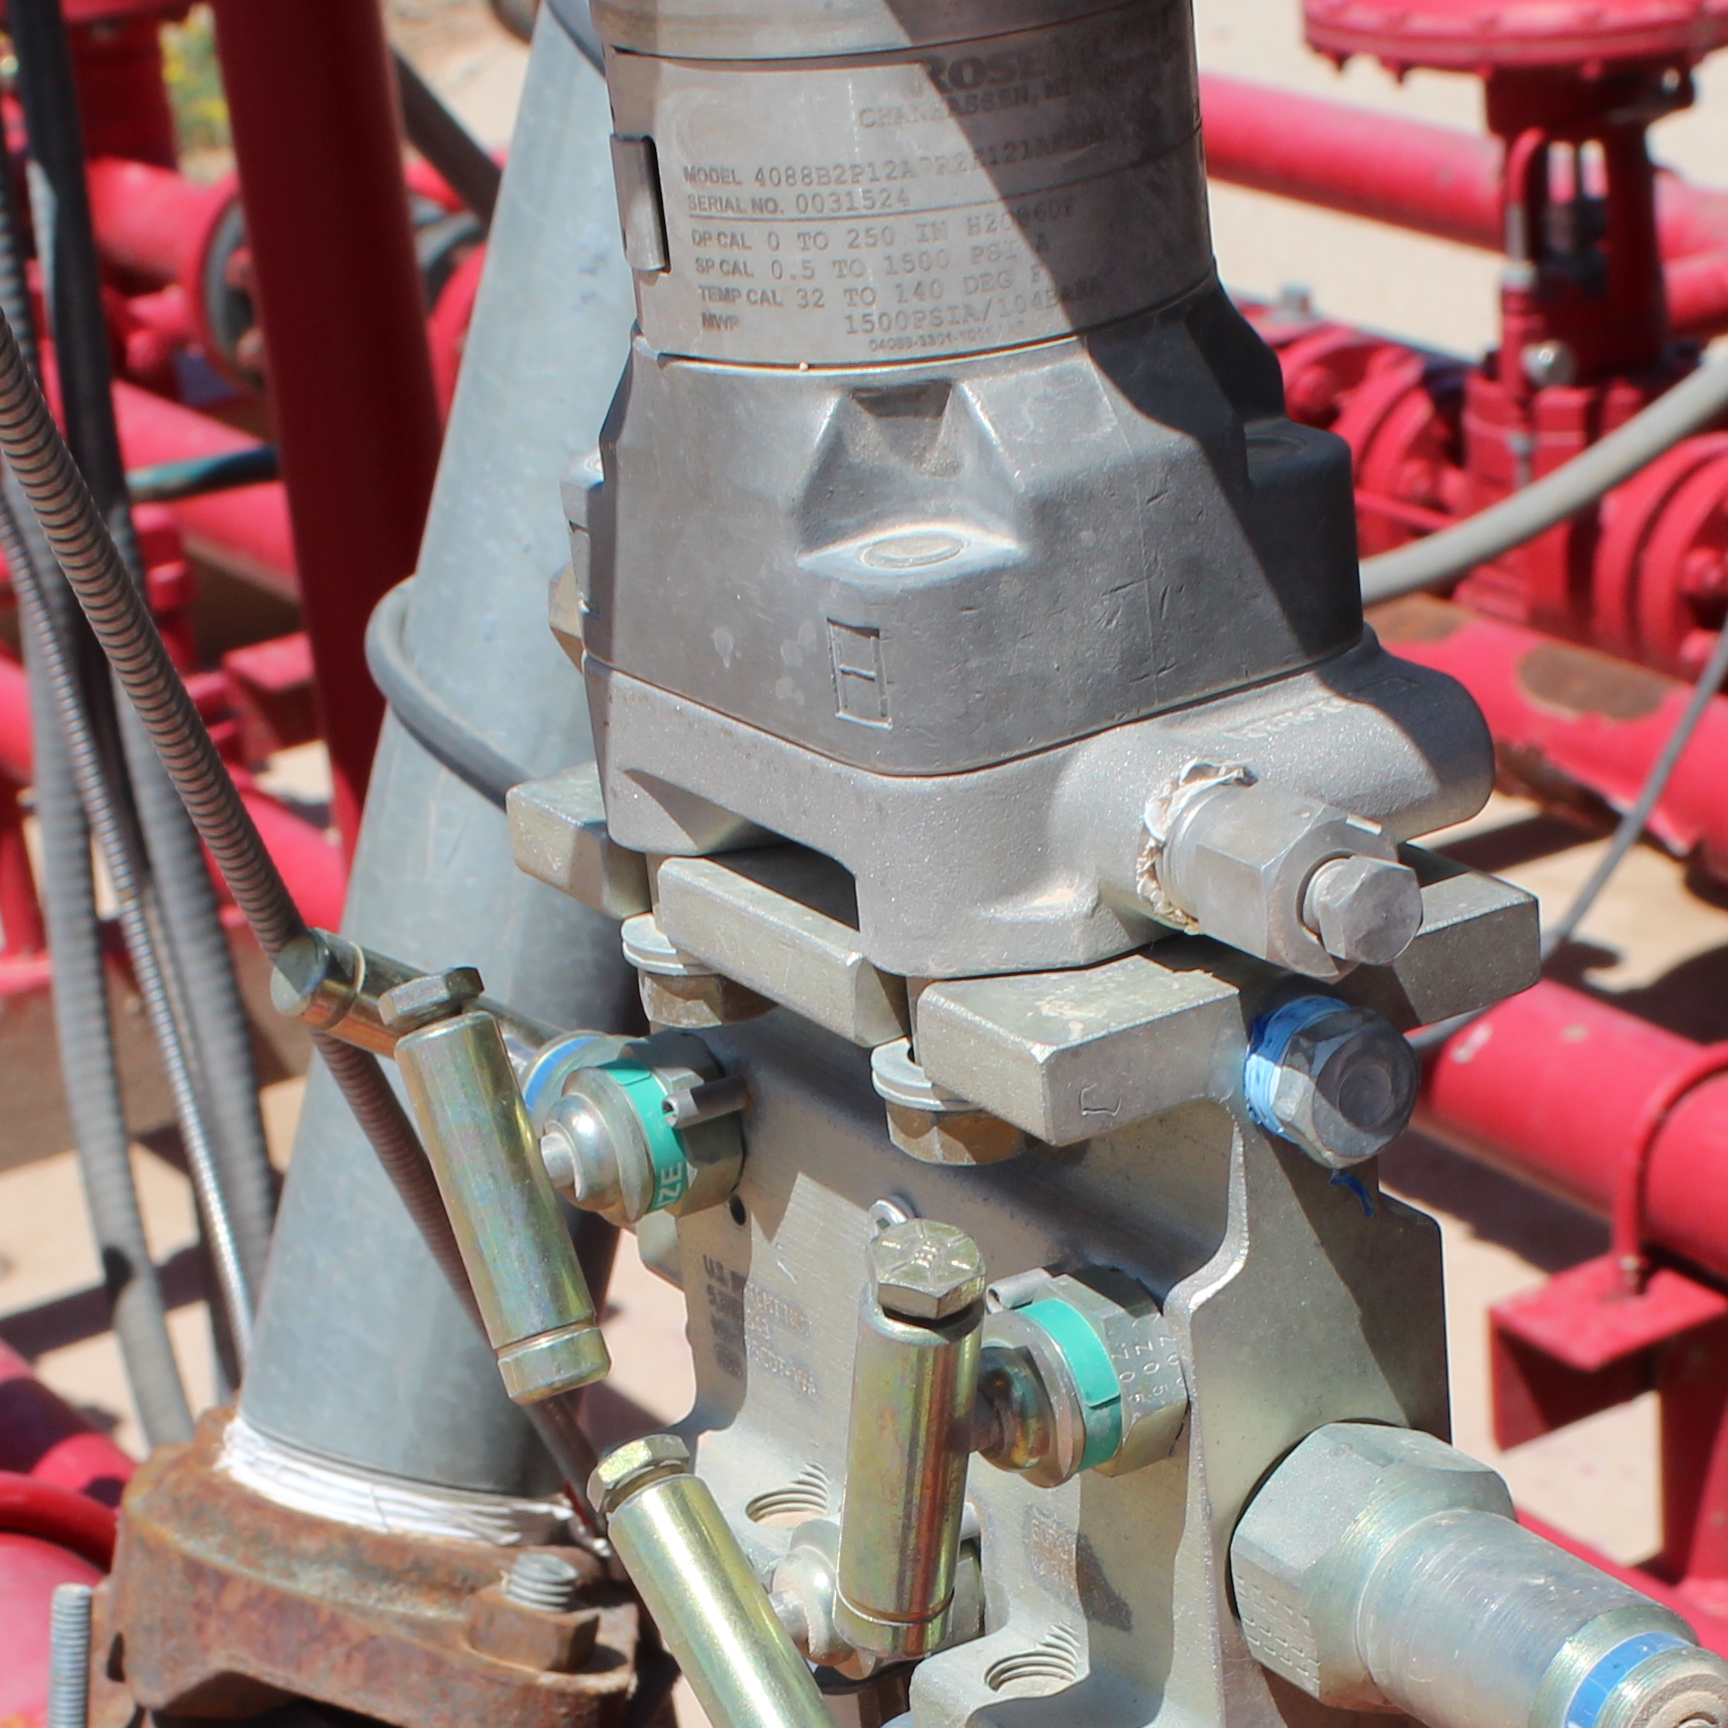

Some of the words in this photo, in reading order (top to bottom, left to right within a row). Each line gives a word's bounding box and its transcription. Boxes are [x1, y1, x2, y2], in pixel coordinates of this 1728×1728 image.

[683, 165, 743, 187] MODEL
[687, 193, 747, 214] SERIAL
[750, 197, 784, 215] NO.
[795, 188, 911, 214] 0031524
[691, 229, 714, 247] DP
[716, 231, 752, 250] CAL
[767, 230, 780, 251] 0
[797, 231, 829, 250] TO
[847, 226, 896, 249] 250
[915, 220, 948, 243] IN
[695, 257, 715, 274] SP
[719, 259, 754, 277] CAL
[770, 259, 815, 280] 0.5
[832, 258, 865, 279] TO
[884, 247, 950, 276] 1500
[699, 285, 742, 304] TEMP
[746, 288, 784, 307] CAL
[796, 288, 825, 308] 32
[843, 287, 876, 307] TO
[895, 278, 945, 304] 140
[963, 270, 1013, 296] DEG
